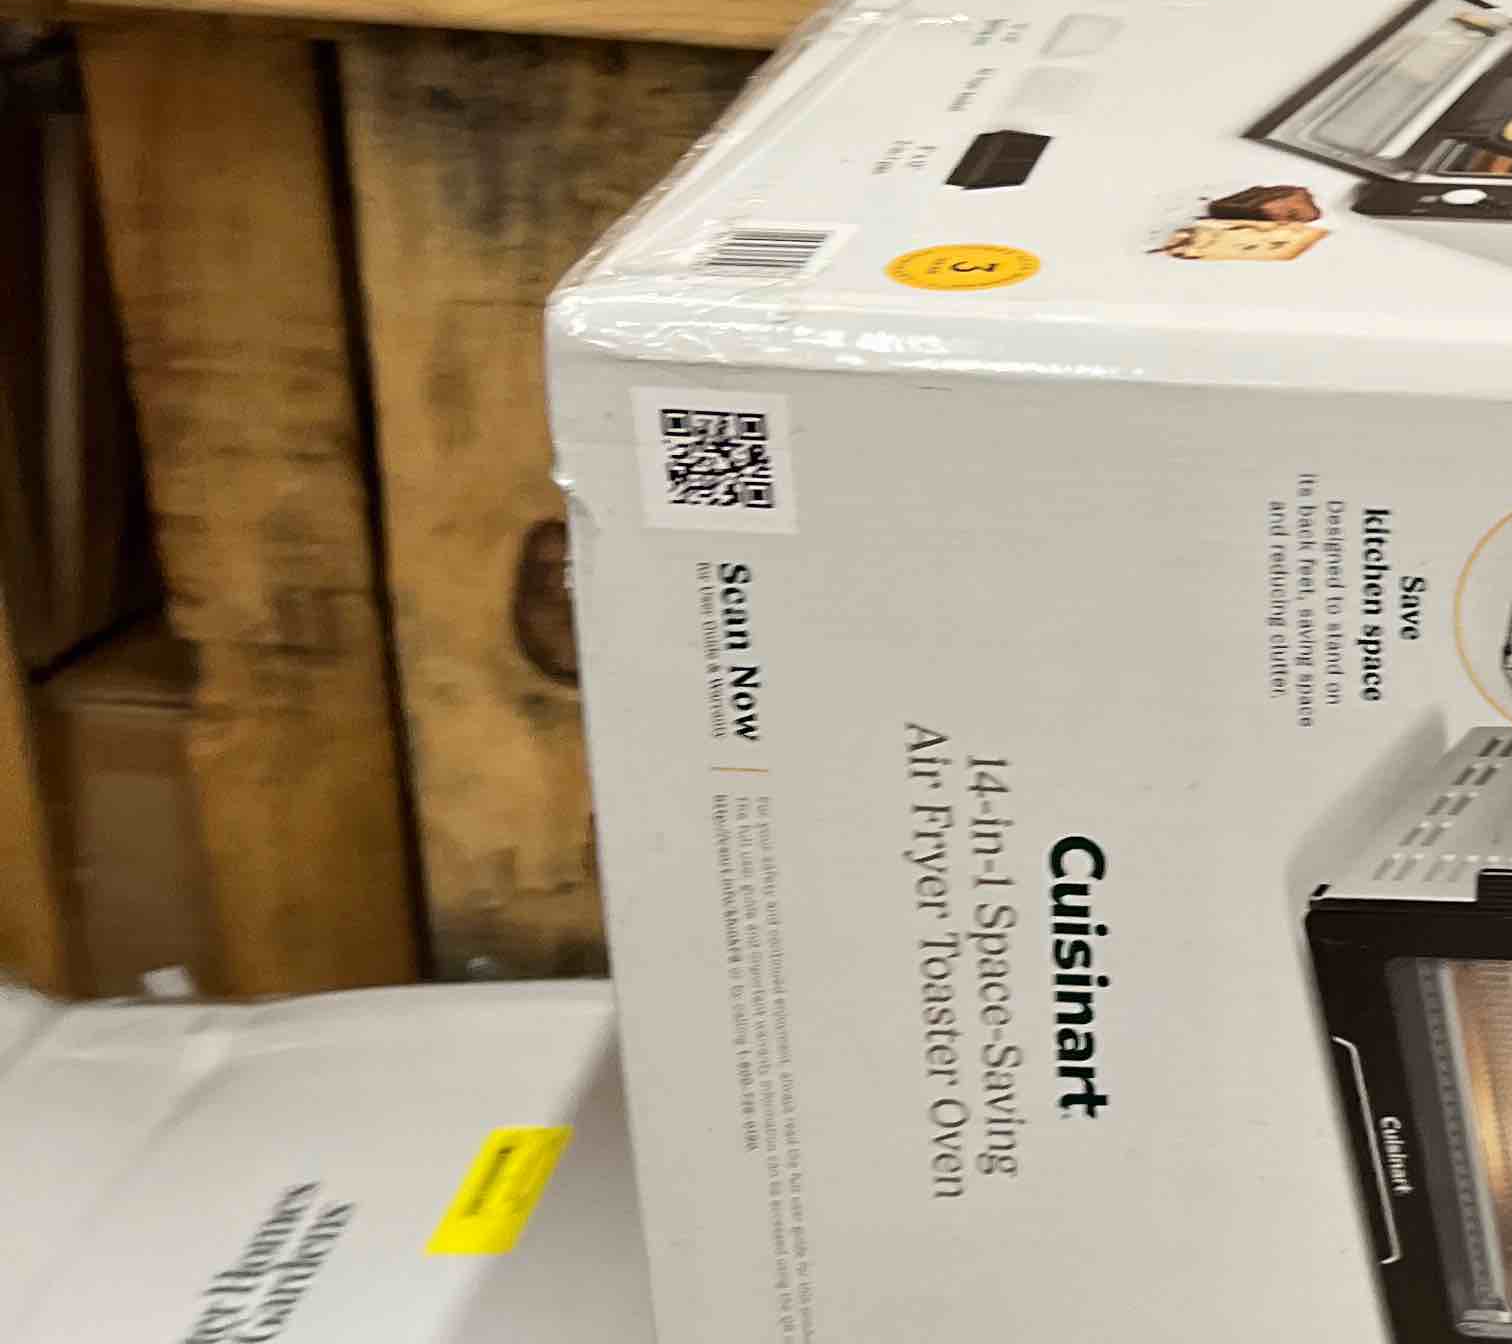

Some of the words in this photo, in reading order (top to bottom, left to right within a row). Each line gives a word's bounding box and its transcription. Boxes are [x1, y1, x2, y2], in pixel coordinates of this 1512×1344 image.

[1269, 501, 1290, 537] and
[1297, 505, 1318, 551] back
[1323, 500, 1346, 589] Designed
[1267, 544, 1290, 627] reducing
[1362, 508, 1392, 616] kitchen
[716, 559, 753, 654] Scan
[1294, 608, 1316, 667] saving
[1326, 596, 1344, 616] to
[1399, 574, 1428, 641] Save
[1325, 623, 1345, 676] stand
[1355, 624, 1384, 702] space
[727, 660, 762, 744] Now
[1294, 673, 1315, 728] space
[1325, 682, 1342, 705] on
[904, 720, 952, 788] Air
[905, 796, 954, 922] Fryer
[918, 929, 961, 1086] Toaster
[1048, 834, 1110, 1119] Cuisinart
[971, 899, 1025, 1180] Space-Saving
[927, 1096, 968, 1202] Oven
